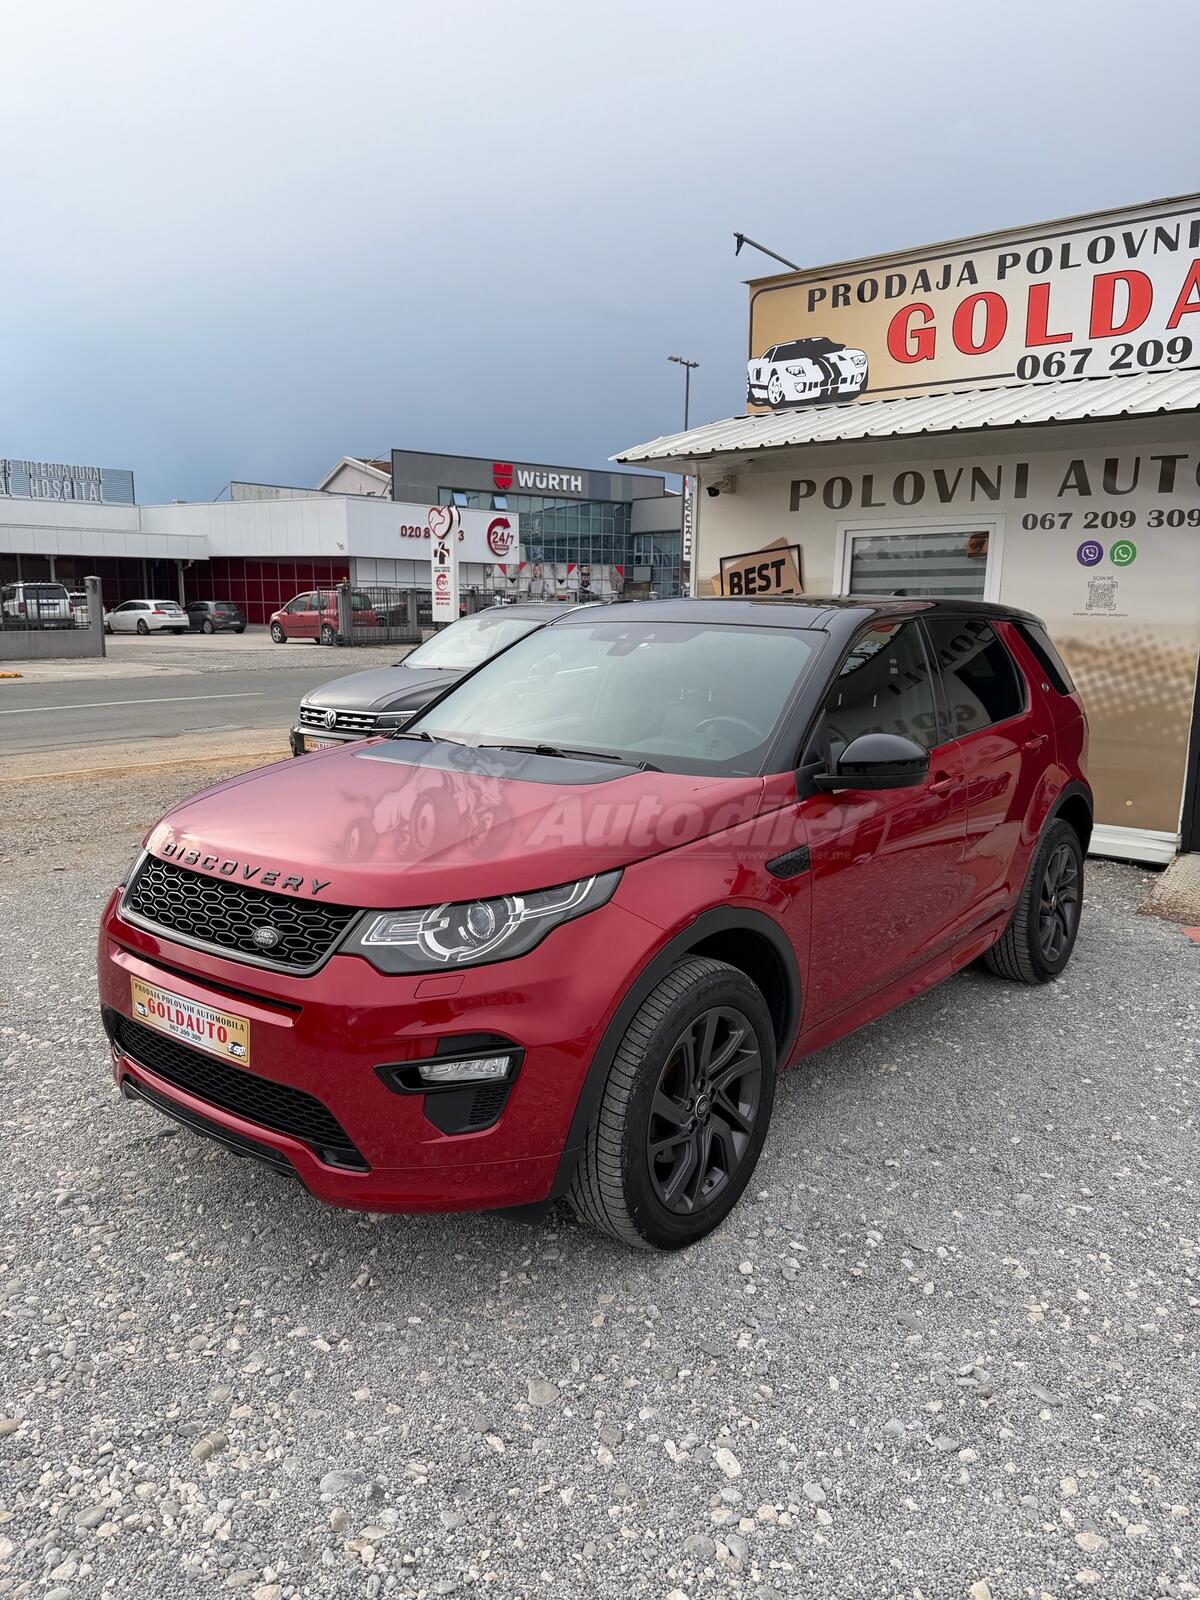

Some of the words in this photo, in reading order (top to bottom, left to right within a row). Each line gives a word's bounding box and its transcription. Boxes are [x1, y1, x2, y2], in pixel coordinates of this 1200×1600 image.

[807, 260, 979, 312] PRODAJA
[1016, 347, 1093, 380] 067
[1108, 336, 1193, 371] 209
[21, 460, 105, 481] INTERNATIONAL
[517, 470, 582, 492] WÜRTH
[789, 462, 1030, 512] POLOVNI
[1057, 454, 1200, 498] AUT
[30, 477, 105, 502] HOSPITAL
[400, 525, 421, 538] 020
[492, 531, 514, 545] 24/7
[1022, 512, 1073, 531] 067
[1083, 510, 1136, 530] 209
[1147, 508, 1200, 528] 309
[729, 558, 786, 595] BEST
[162, 843, 332, 895] DISCOVERY
[134, 983, 161, 1001] PRODAJA
[161, 995, 195, 1014] POLOVNIH
[196, 1009, 245, 1032] AUTOMOBILA
[147, 997, 228, 1044] GOLDAUTO
